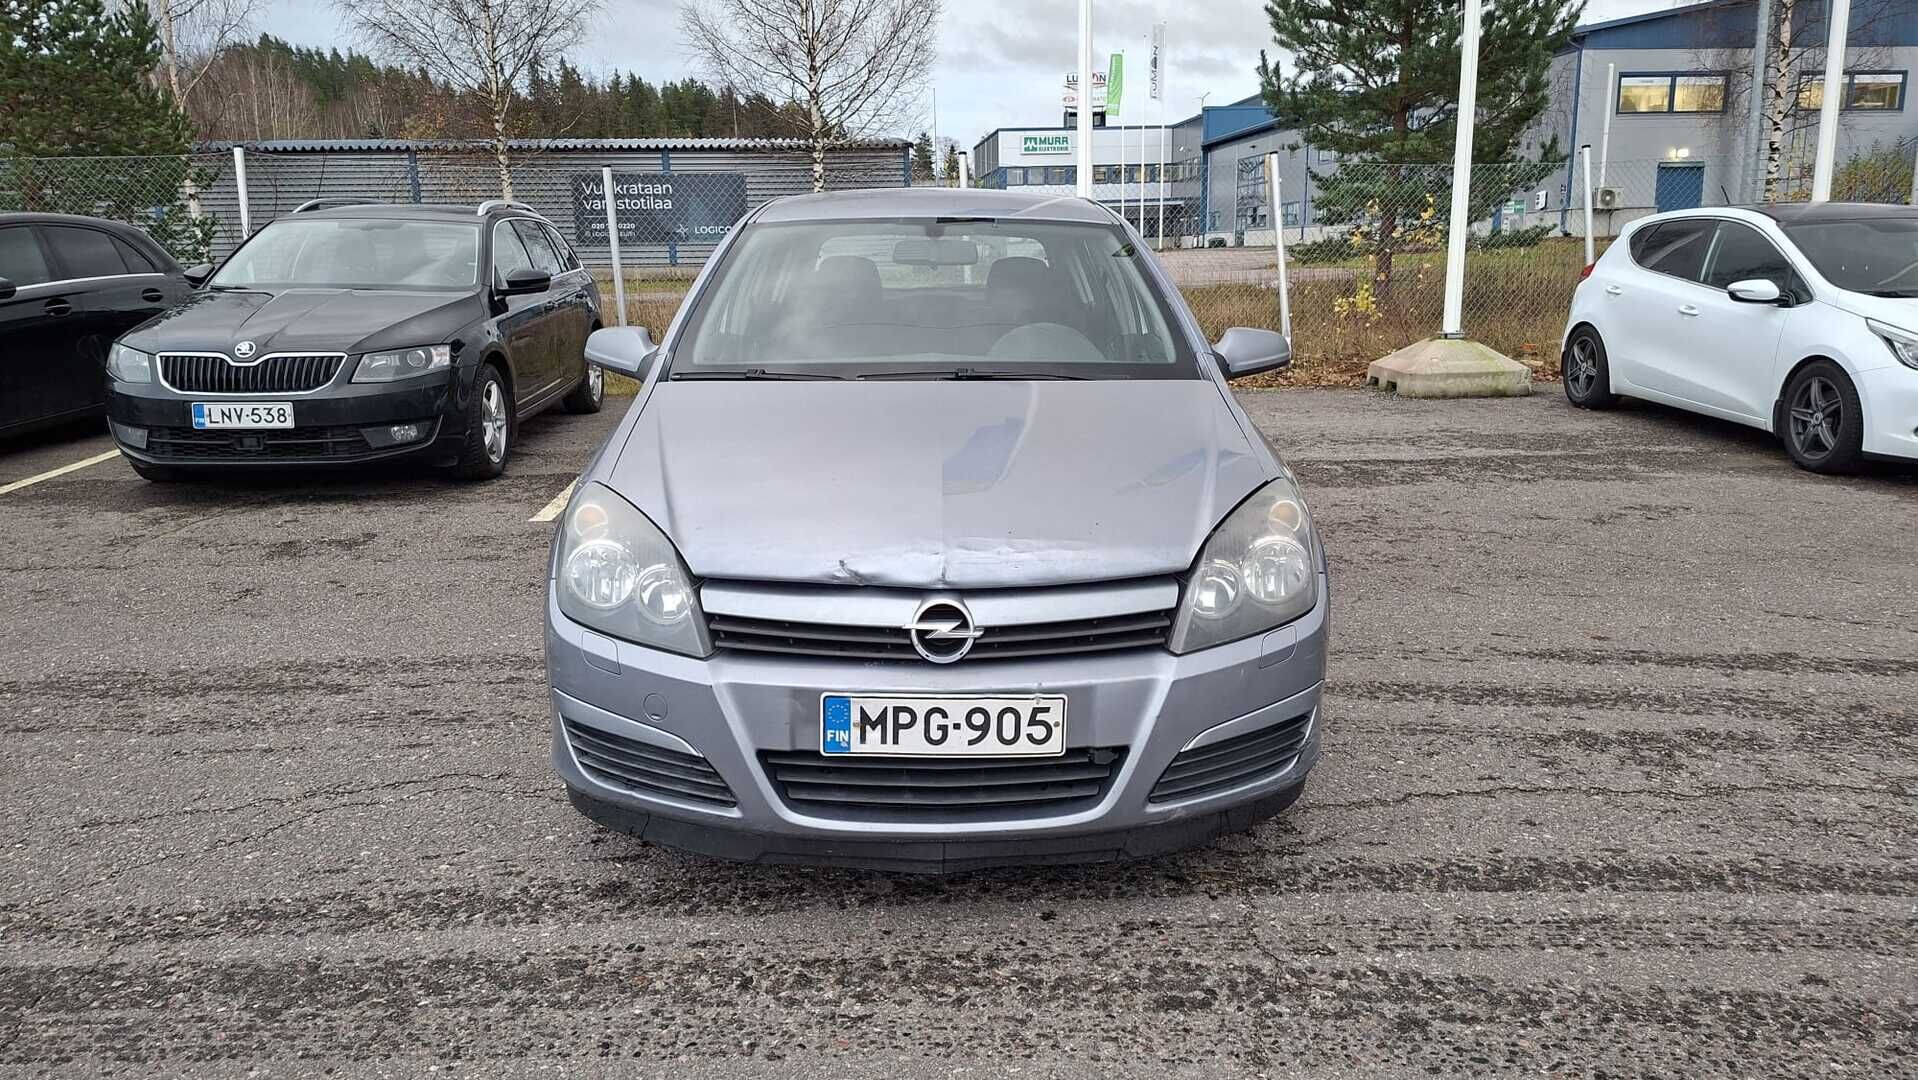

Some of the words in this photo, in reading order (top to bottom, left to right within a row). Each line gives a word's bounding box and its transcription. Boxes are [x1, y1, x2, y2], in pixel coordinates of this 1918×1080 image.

[581, 181, 672, 195] Vukrataan
[582, 197, 672, 210] varstotilaa
[208, 407, 287, 424] LNV-538
[859, 705, 1053, 746] MPG-905
[827, 729, 849, 742] FIN
